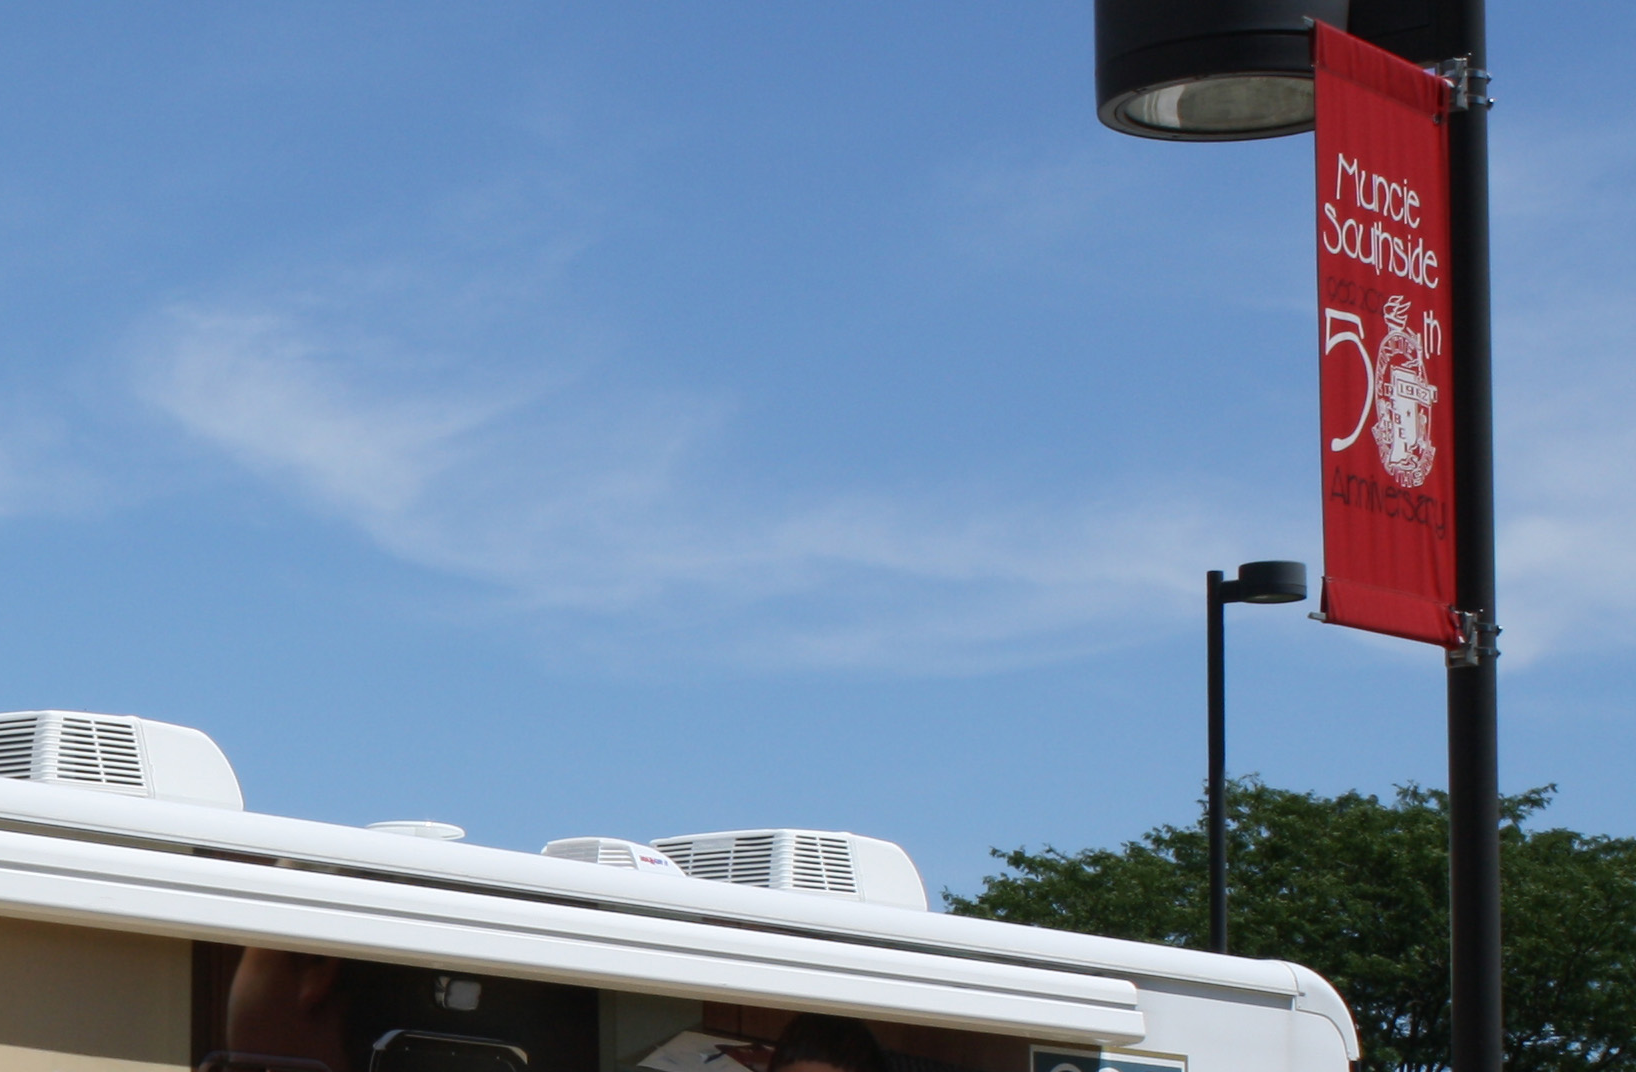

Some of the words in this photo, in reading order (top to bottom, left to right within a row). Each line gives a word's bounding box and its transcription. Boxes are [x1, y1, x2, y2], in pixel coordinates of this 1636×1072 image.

[1336, 153, 1420, 229] Muncie
[1323, 202, 1439, 289] Southside
[1331, 465, 1446, 540] Anniversary
